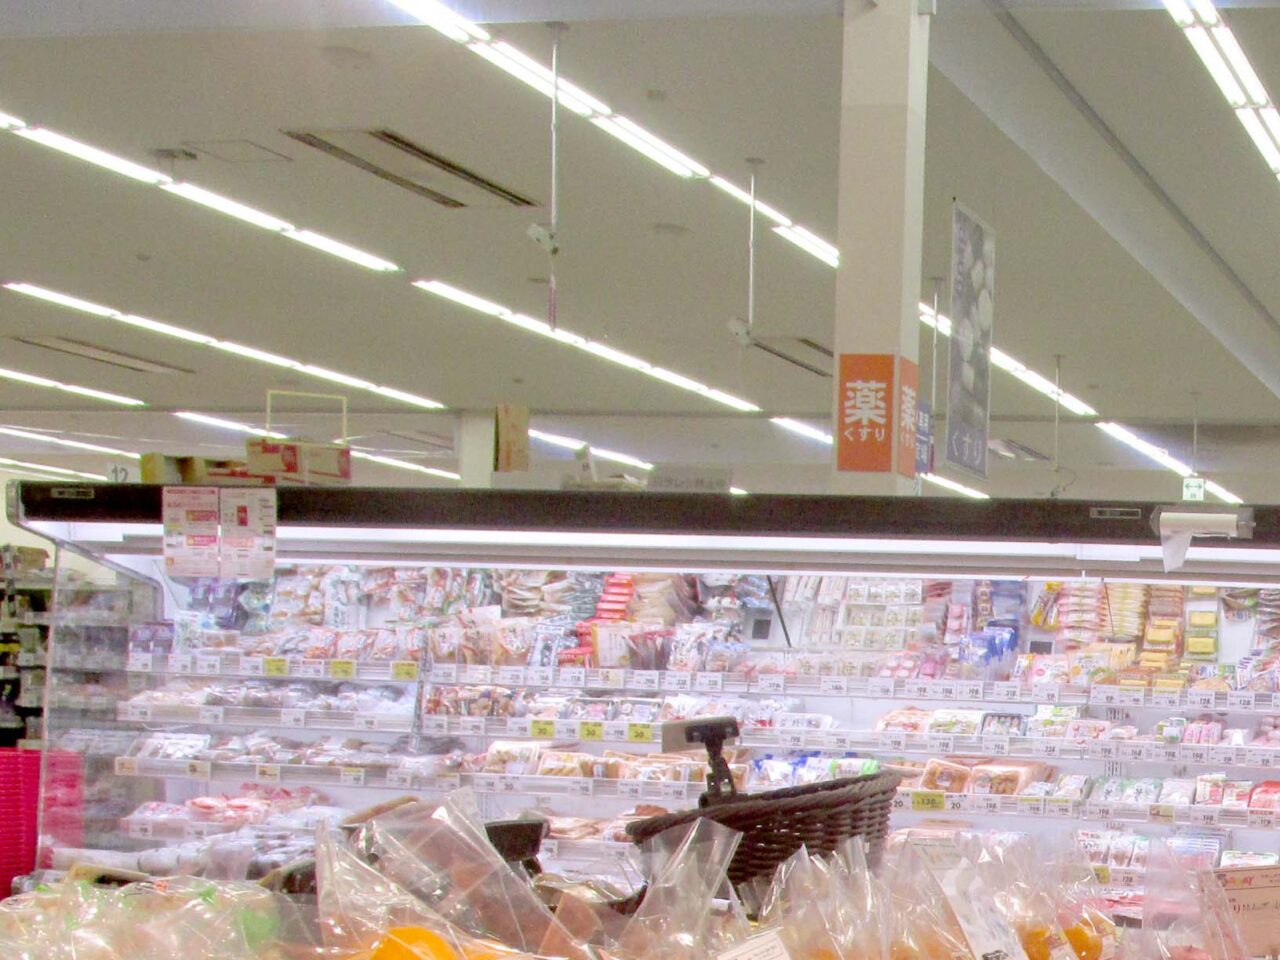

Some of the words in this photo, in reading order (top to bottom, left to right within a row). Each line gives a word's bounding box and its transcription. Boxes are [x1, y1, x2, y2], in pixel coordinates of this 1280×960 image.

[845, 379, 888, 426] 薬
[844, 426, 886, 442] くすり
[951, 431, 984, 466] くすり
